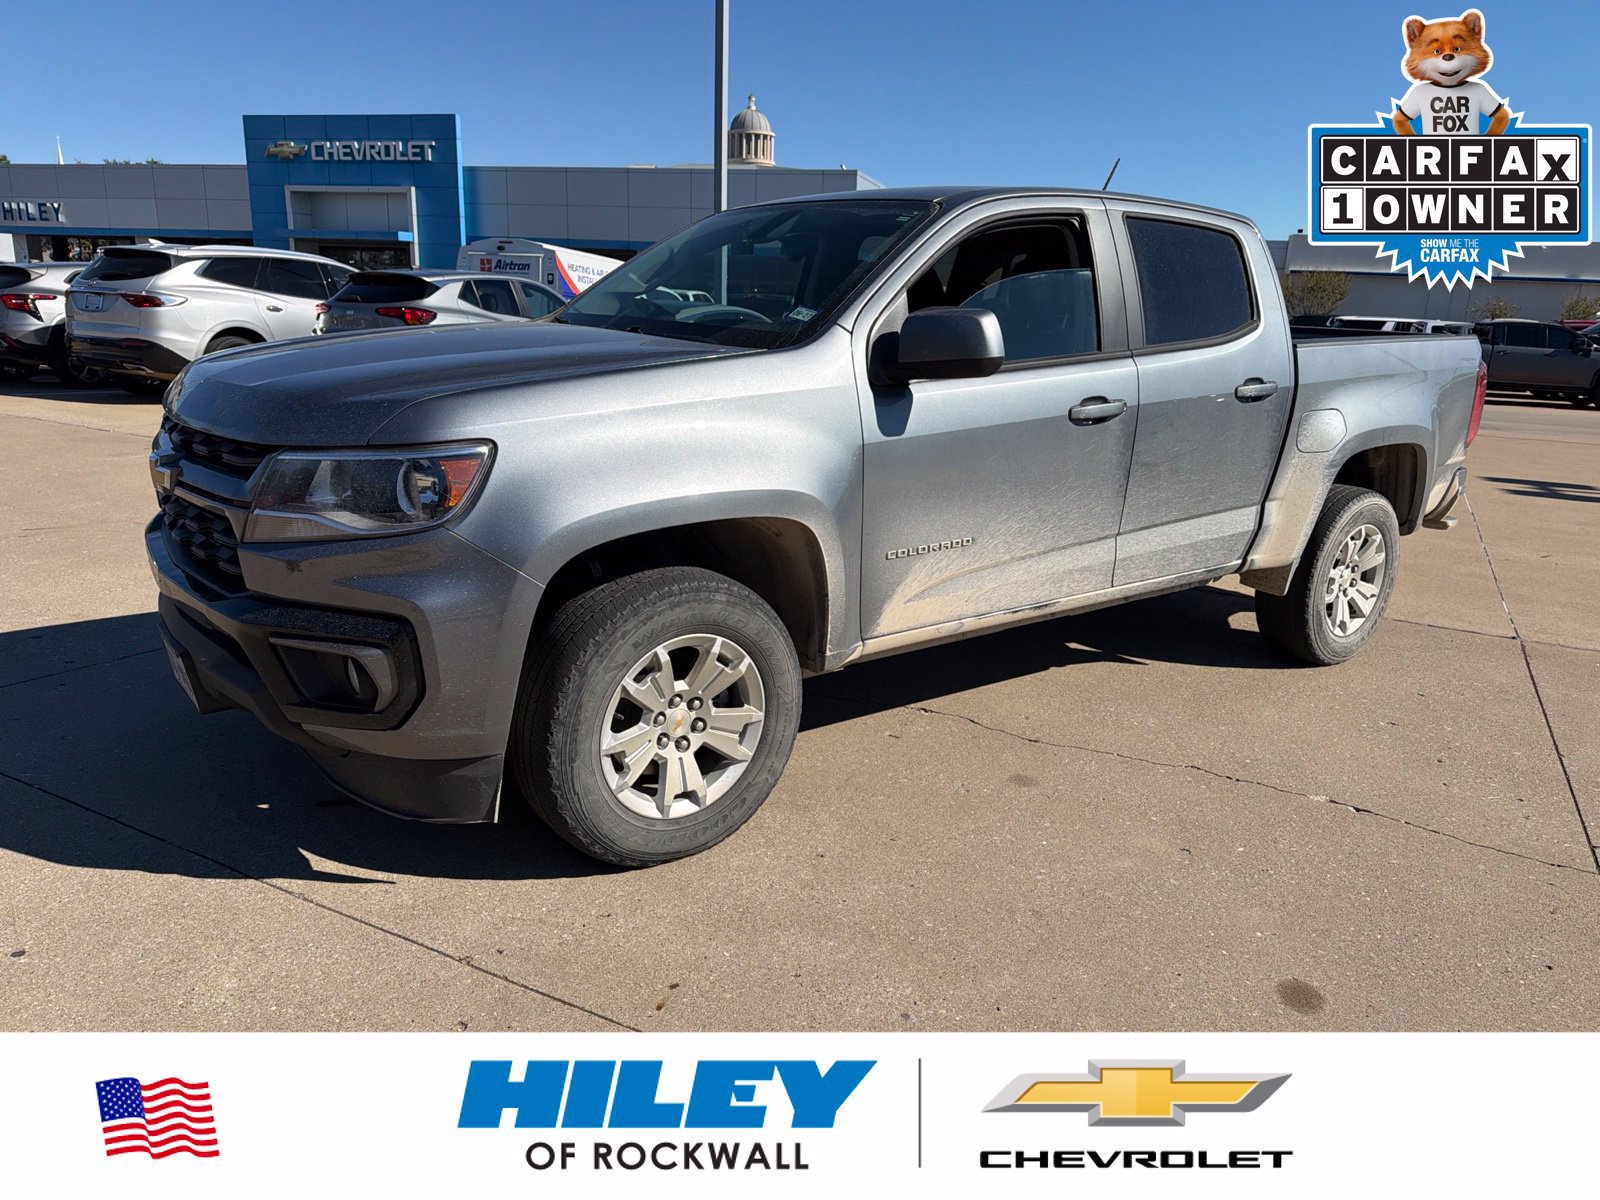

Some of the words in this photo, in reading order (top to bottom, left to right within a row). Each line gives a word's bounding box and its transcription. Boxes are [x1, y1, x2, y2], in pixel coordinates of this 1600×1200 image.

[310, 140, 434, 161] CHEVROLET
[2, 202, 61, 221] HILEY
[493, 259, 531, 271] Airtron
[567, 263, 591, 275] HEATING
[885, 537, 974, 560] COLORADO
